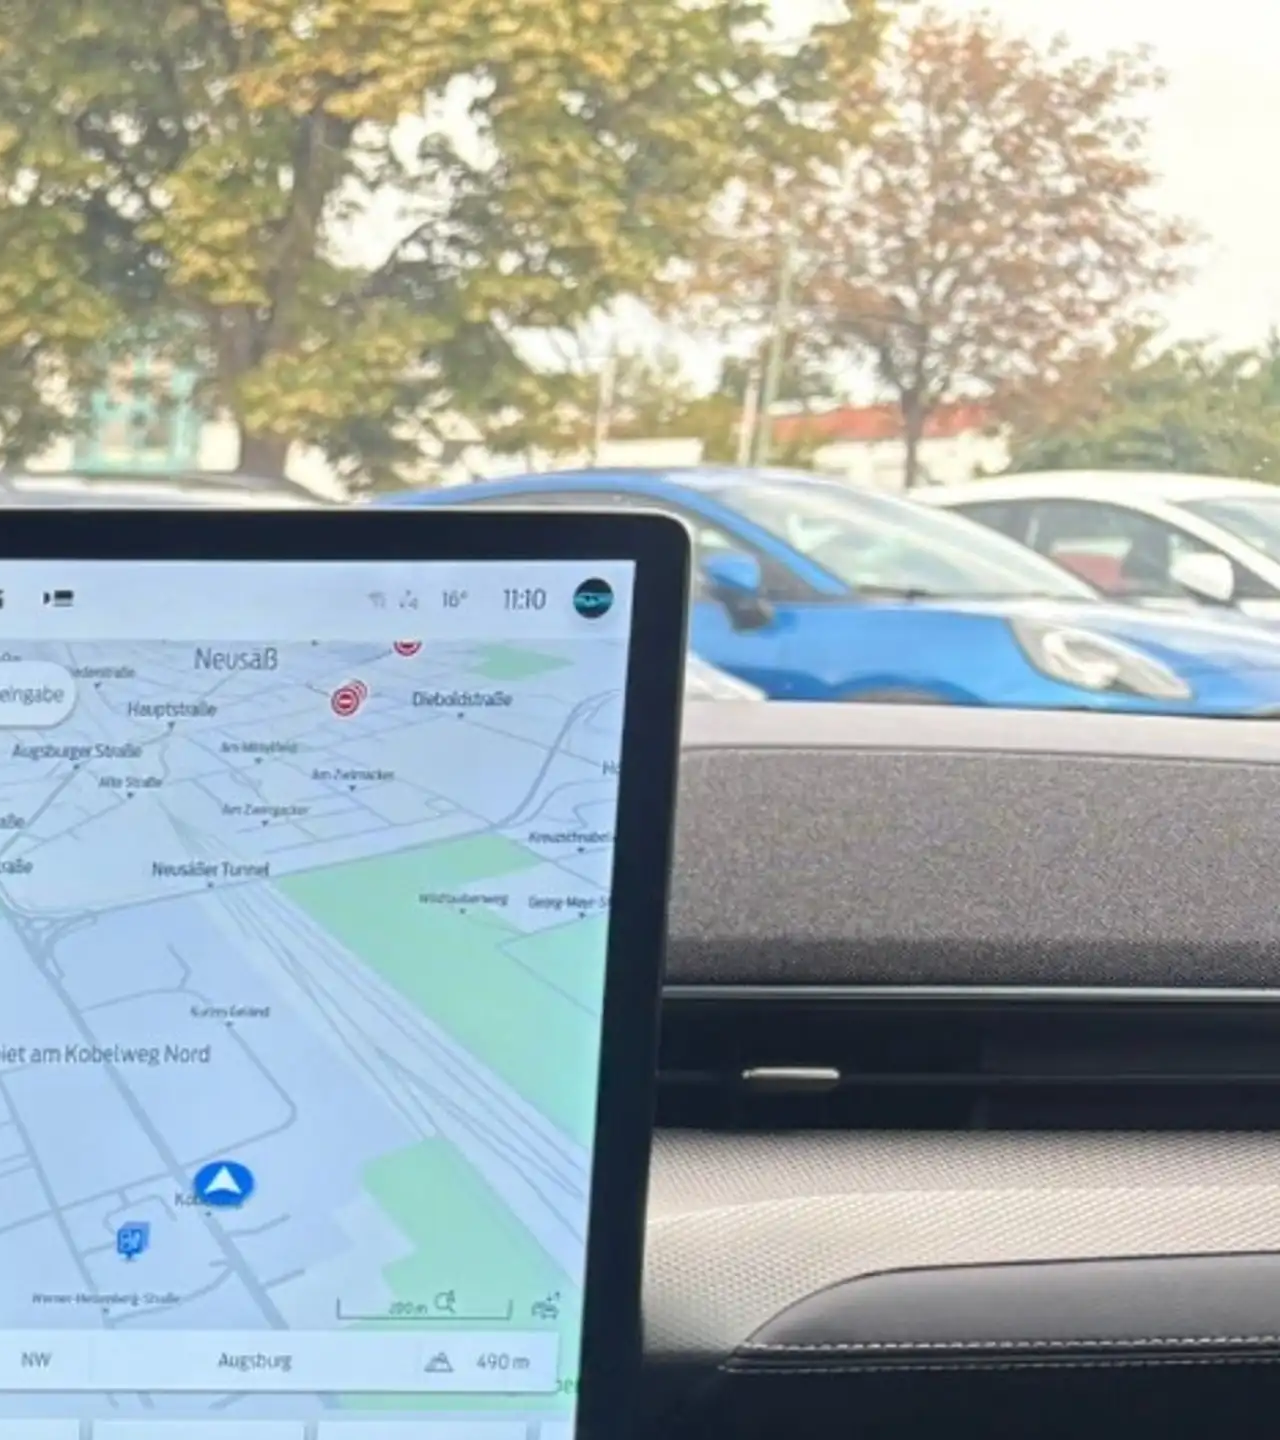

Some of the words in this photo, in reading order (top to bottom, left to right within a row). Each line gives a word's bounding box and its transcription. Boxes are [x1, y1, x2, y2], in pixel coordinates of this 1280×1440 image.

[504, 588, 546, 610] 11:10
[195, 647, 278, 670] Neusäß
[412, 690, 513, 708] Dieboldstraße
[128, 701, 217, 719] Hauptstraße
[12, 743, 91, 759] Augsburger
[94, 743, 143, 757] Straße
[125, 777, 162, 788] Straße
[221, 861, 269, 877] Tunnel
[31, 1049, 61, 1062] am
[65, 1044, 161, 1065] Kobelweg
[165, 1044, 211, 1062] Nord
[21, 1353, 52, 1367] NW
[218, 1352, 293, 1371] Augsburg
[476, 1355, 509, 1370] 490
[512, 1358, 530, 1370] m
